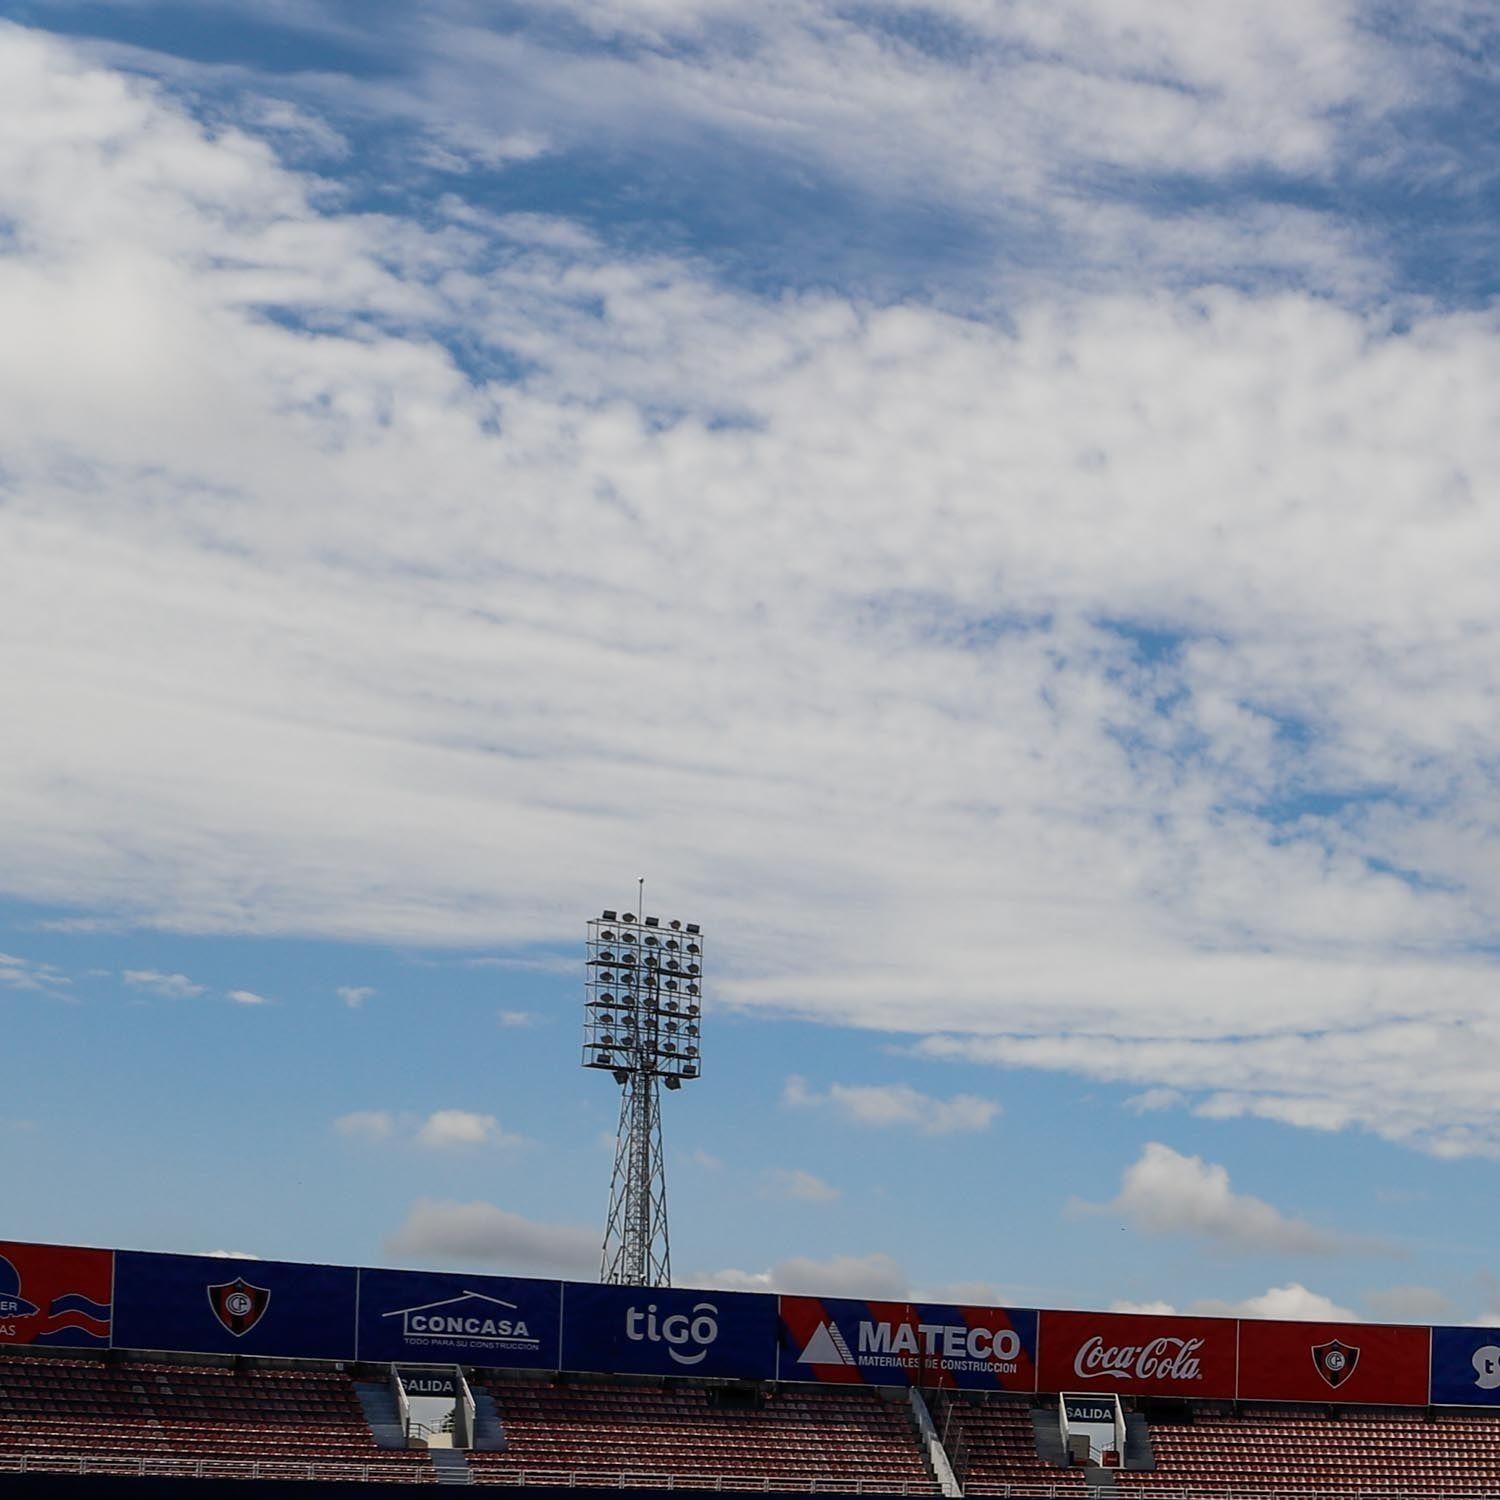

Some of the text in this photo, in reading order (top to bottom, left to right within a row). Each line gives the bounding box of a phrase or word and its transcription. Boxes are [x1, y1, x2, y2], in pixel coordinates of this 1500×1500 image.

[411, 1315, 530, 1337] CONCASA
[858, 1320, 1021, 1361] MATECO
[858, 1356, 920, 1369] MATERIALES
[925, 1358, 938, 1369] DE
[1074, 1336, 1205, 1379] Coca-Cola
